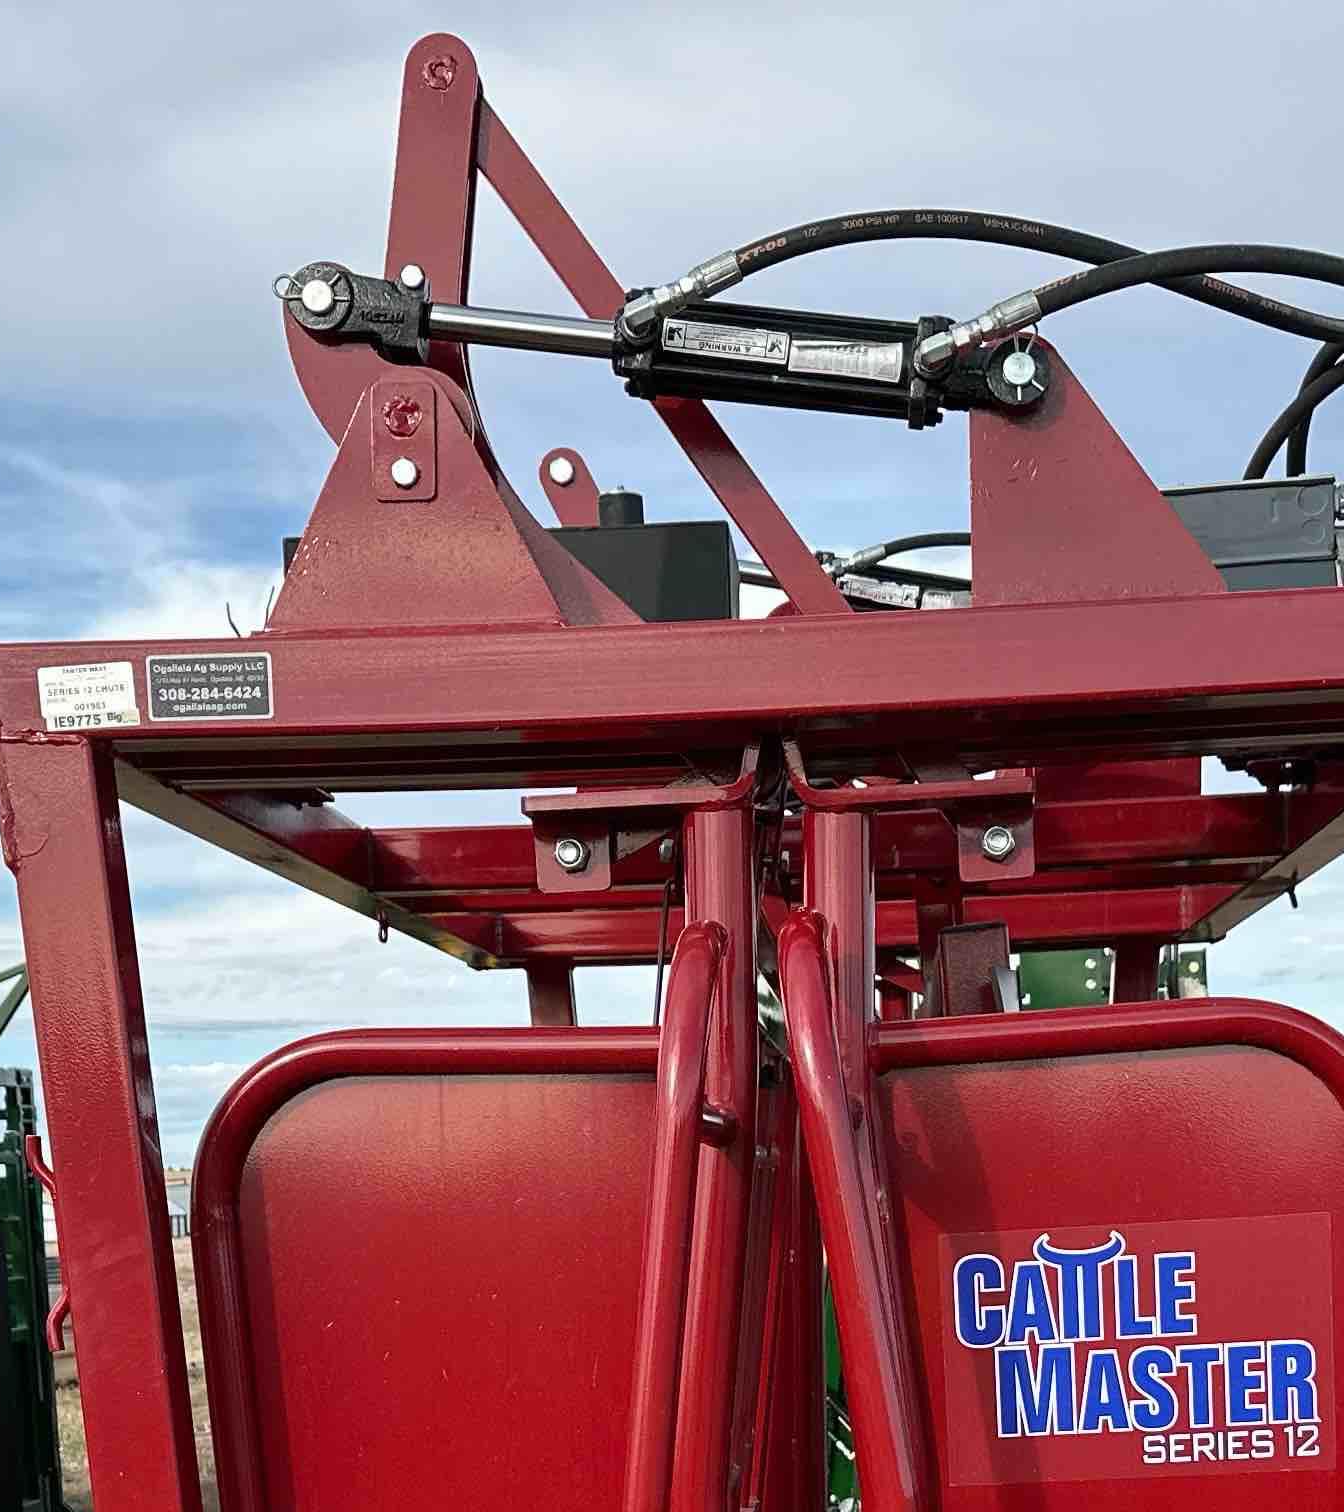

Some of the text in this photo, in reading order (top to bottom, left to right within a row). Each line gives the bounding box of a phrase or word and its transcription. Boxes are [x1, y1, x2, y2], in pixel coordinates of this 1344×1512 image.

[193, 662, 208, 674] Ag
[209, 662, 243, 673] Supply
[244, 661, 265, 671] LLC
[158, 685, 262, 701] 308-284-6424
[953, 1231, 1198, 1348] CATTLE
[994, 1338, 1322, 1439] MASTER
[1142, 1424, 1321, 1466] SERIES 12
